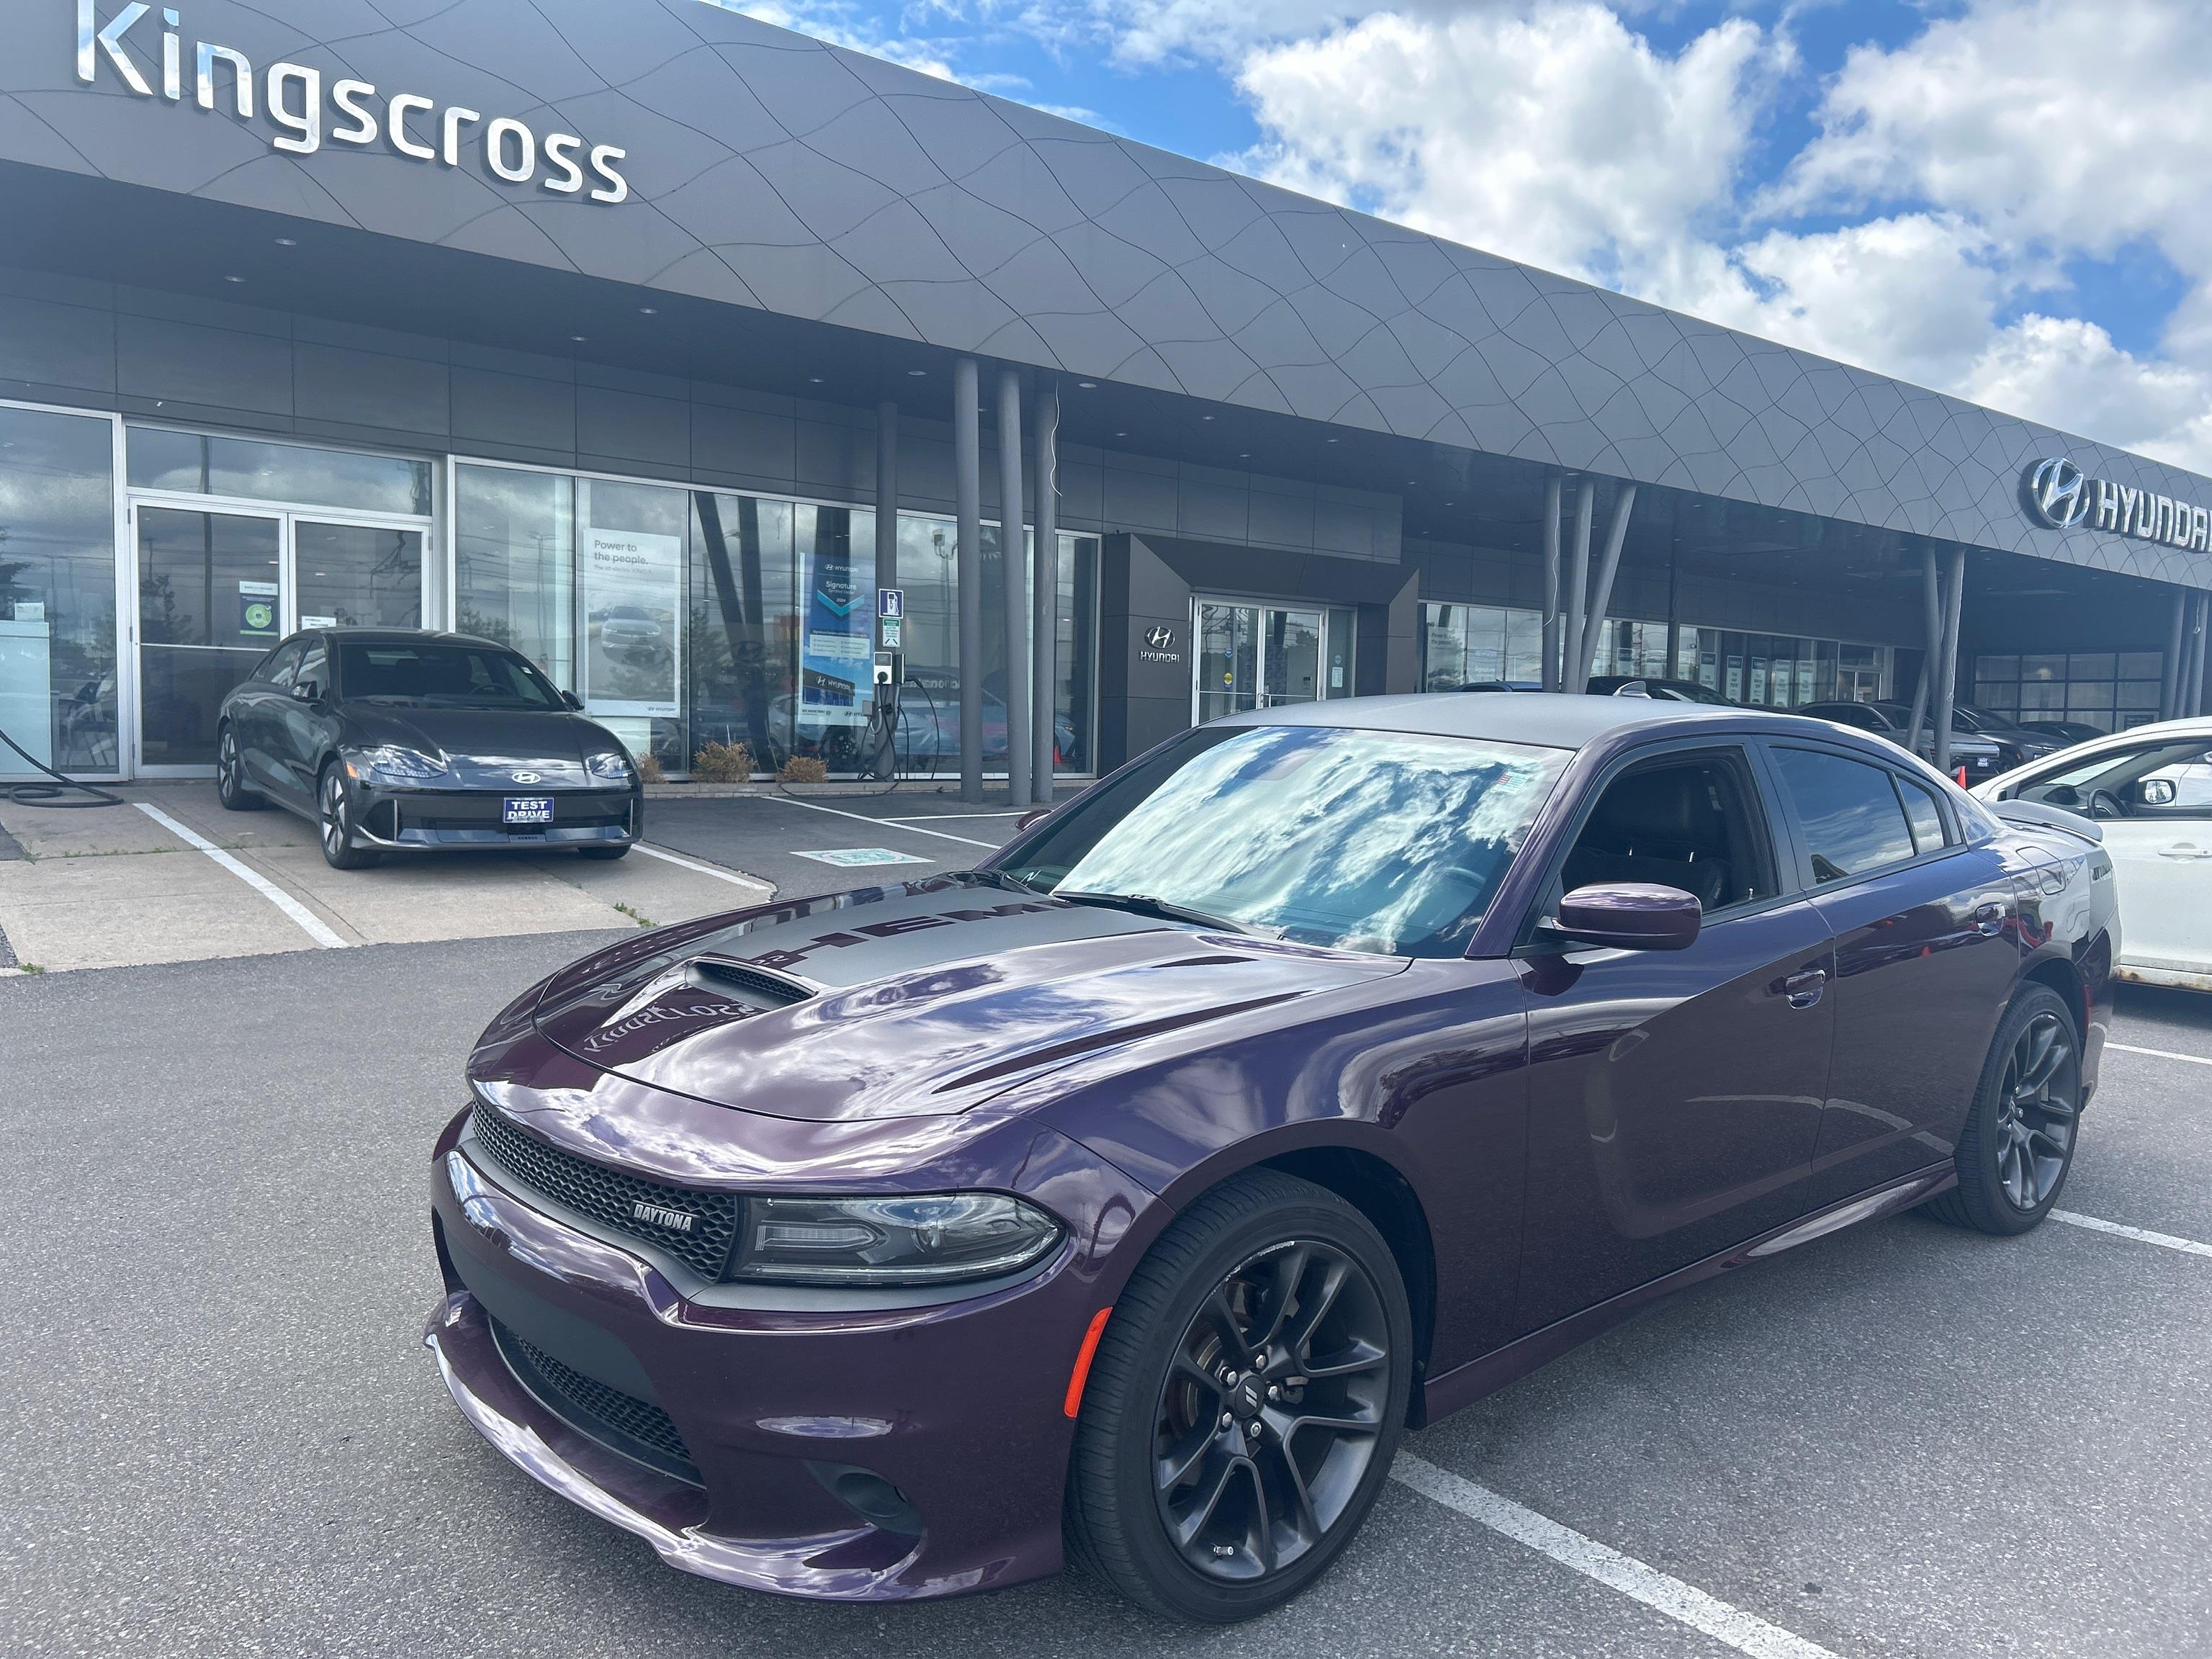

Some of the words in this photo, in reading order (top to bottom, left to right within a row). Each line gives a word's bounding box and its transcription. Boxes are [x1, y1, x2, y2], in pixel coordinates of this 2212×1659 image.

[77, 0, 629, 204] Kingscross
[594, 539, 625, 552] Power
[627, 543, 637, 552] to
[593, 552, 611, 562] the
[612, 554, 649, 565] people.
[826, 580, 858, 590] Signature
[1141, 650, 1179, 663] HYUNDAI
[827, 679, 852, 691] HYUNDAI
[511, 801, 547, 810] TEST
[508, 810, 550, 819] DRIVE
[751, 899, 1084, 972] HEMI
[634, 1203, 693, 1231] DAYTONA
